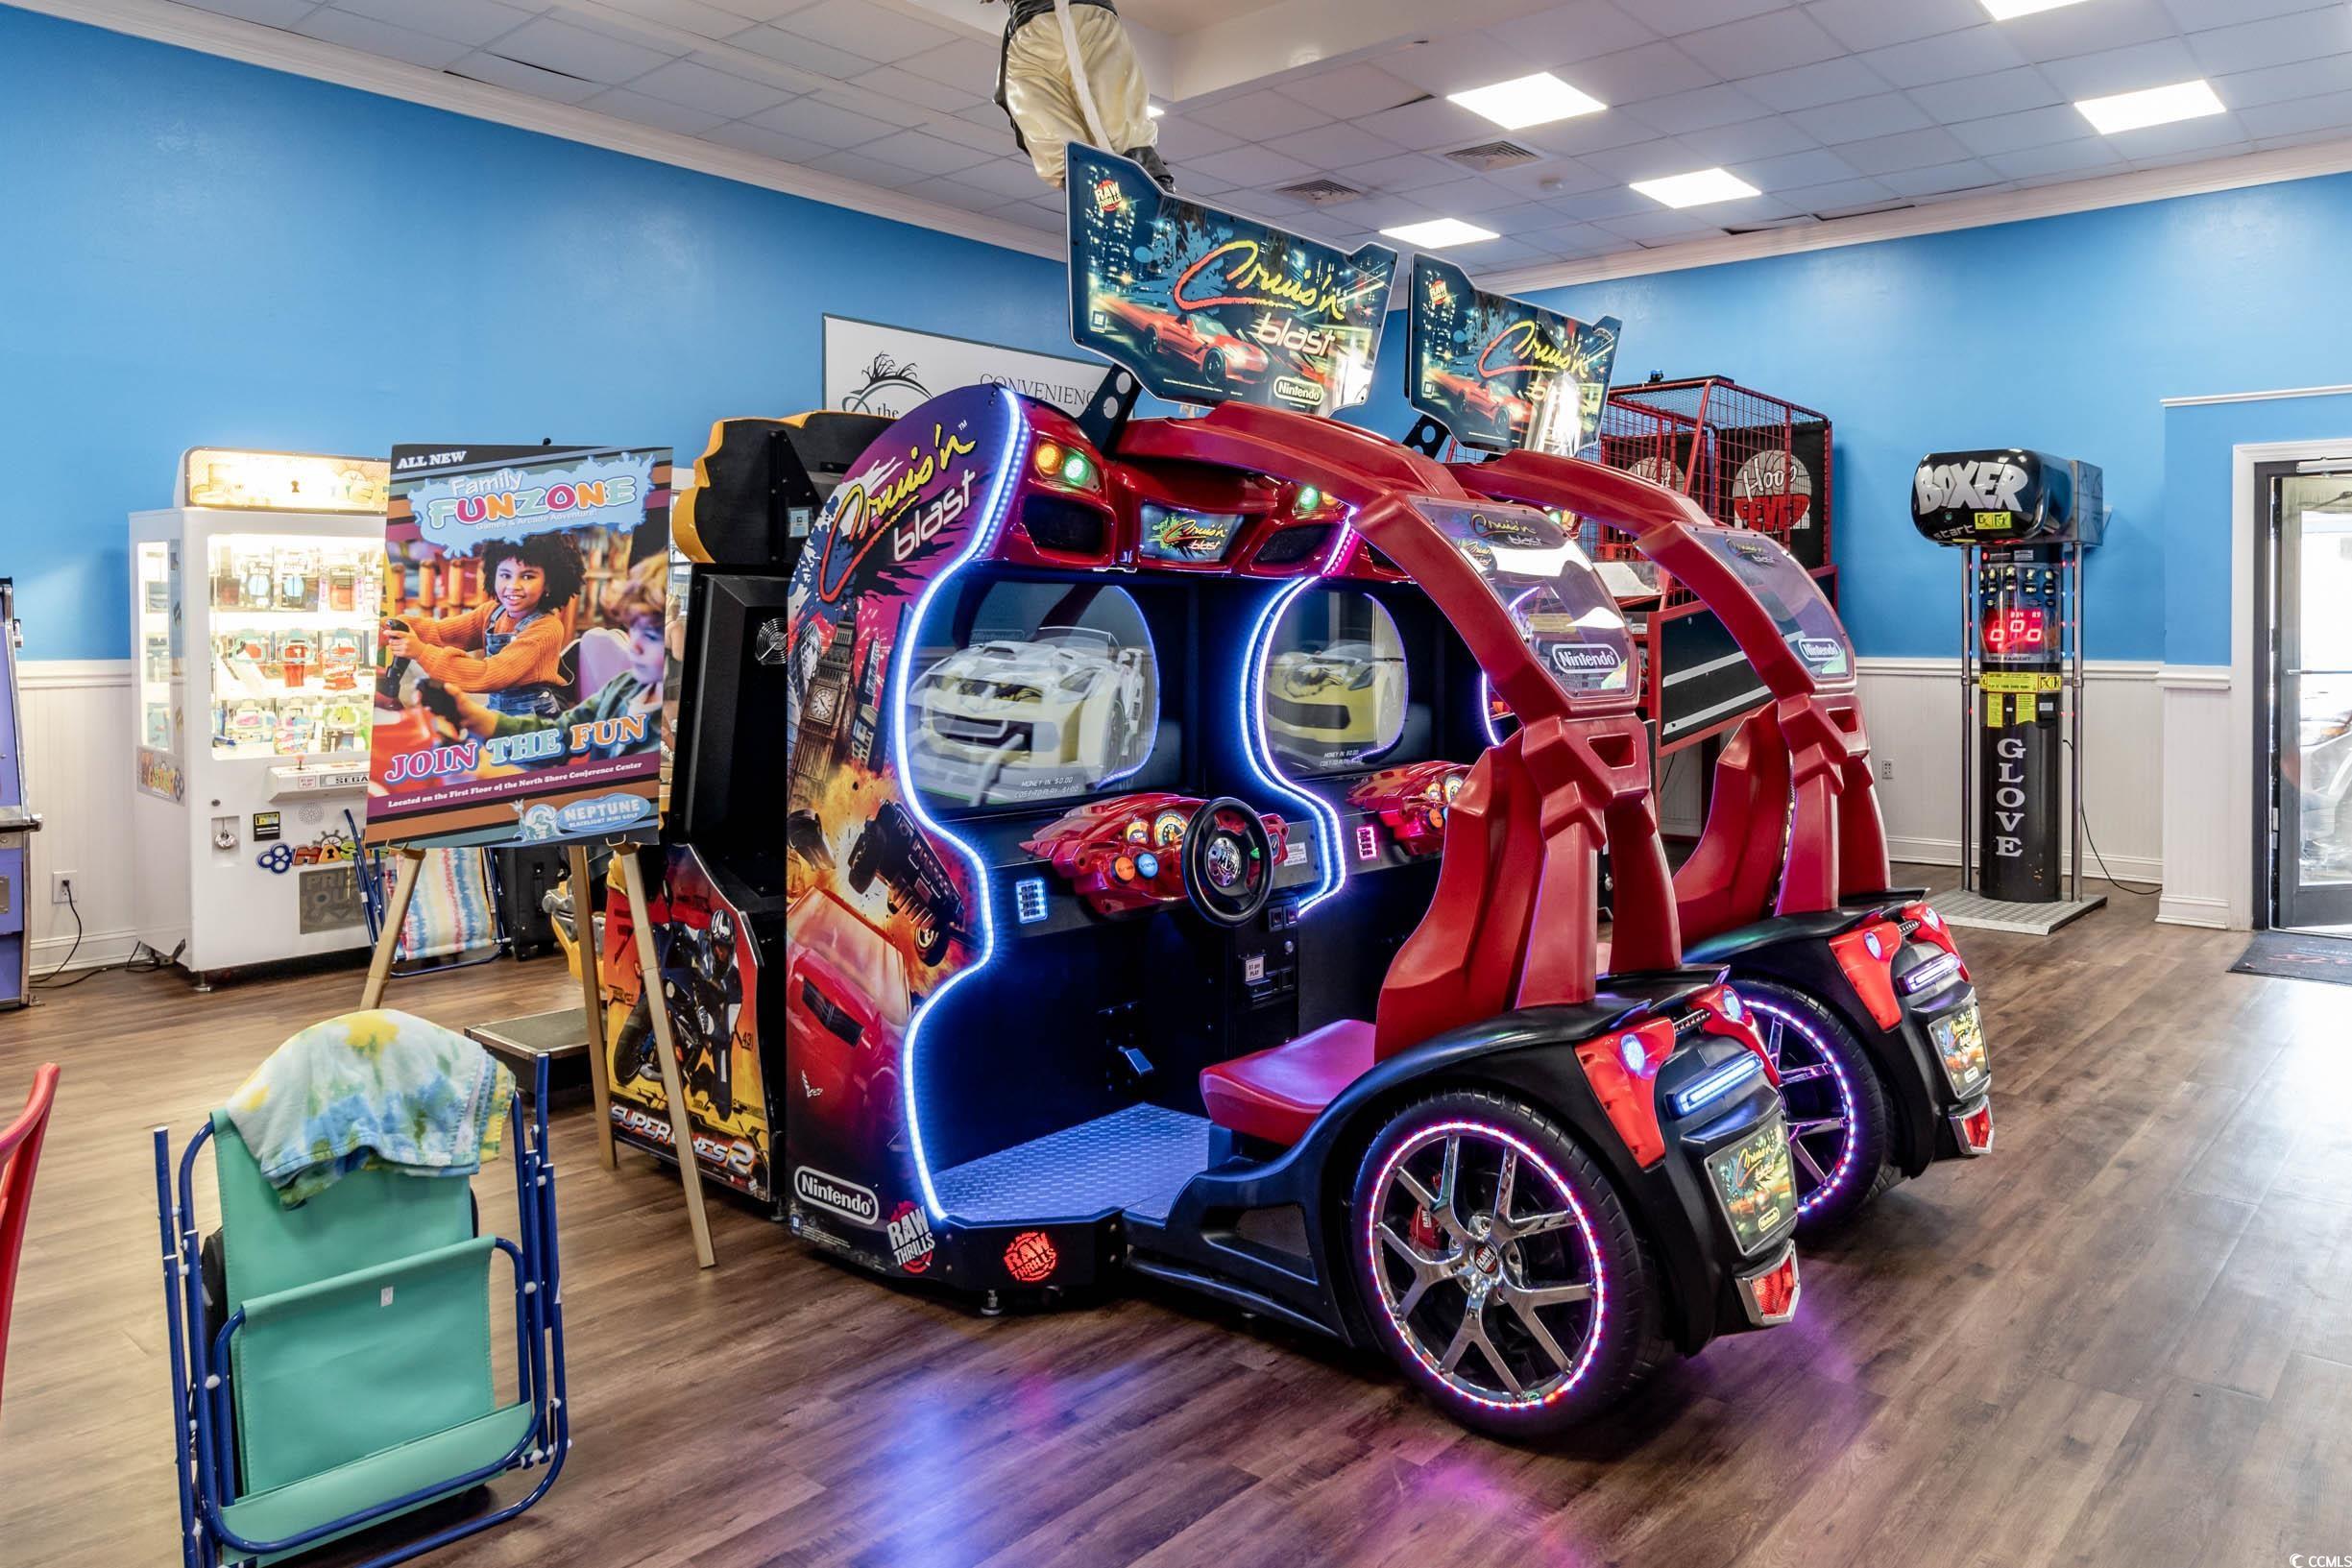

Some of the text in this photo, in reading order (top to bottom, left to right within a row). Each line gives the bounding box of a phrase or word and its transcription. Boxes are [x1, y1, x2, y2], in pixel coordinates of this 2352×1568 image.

[1095, 181, 1121, 202] RAW
[1174, 240, 1345, 320] Cruis'n
[1254, 312, 1336, 357] blast
[1277, 380, 1321, 401] Nintendo
[397, 450, 467, 470] ALL NEW
[450, 470, 523, 496] Family
[1914, 460, 2028, 516] BOXER
[428, 475, 637, 529] FUNZONE
[820, 424, 976, 603] Cruis'n
[894, 469, 976, 562] blast
[476, 519, 507, 530] Games
[517, 514, 550, 525] Arcade
[1163, 519, 1226, 544] Cruis'n
[1189, 540, 1221, 550] blast
[1557, 651, 1616, 667] Nintendo
[1803, 642, 1838, 657] Nintendo
[385, 713, 648, 783] JOIN THE FUN
[335, 776, 369, 784] SEGA
[387, 796, 421, 808] Located
[449, 789, 469, 798] First
[470, 786, 492, 795] Floor
[519, 777, 543, 787] North
[545, 773, 568, 783] Shore
[569, 766, 615, 779] Conference
[616, 761, 643, 772] Center
[1996, 737, 2026, 857] GLOVE
[564, 799, 641, 822] NEPTUNE
[726, 1141, 755, 1177] 2
[801, 1173, 874, 1217] Nintendo
[886, 1205, 931, 1249] RAW
[893, 1232, 936, 1266] THRILLS
[1005, 1232, 1050, 1271] RAW
[1011, 1247, 1057, 1281] THRILLS
